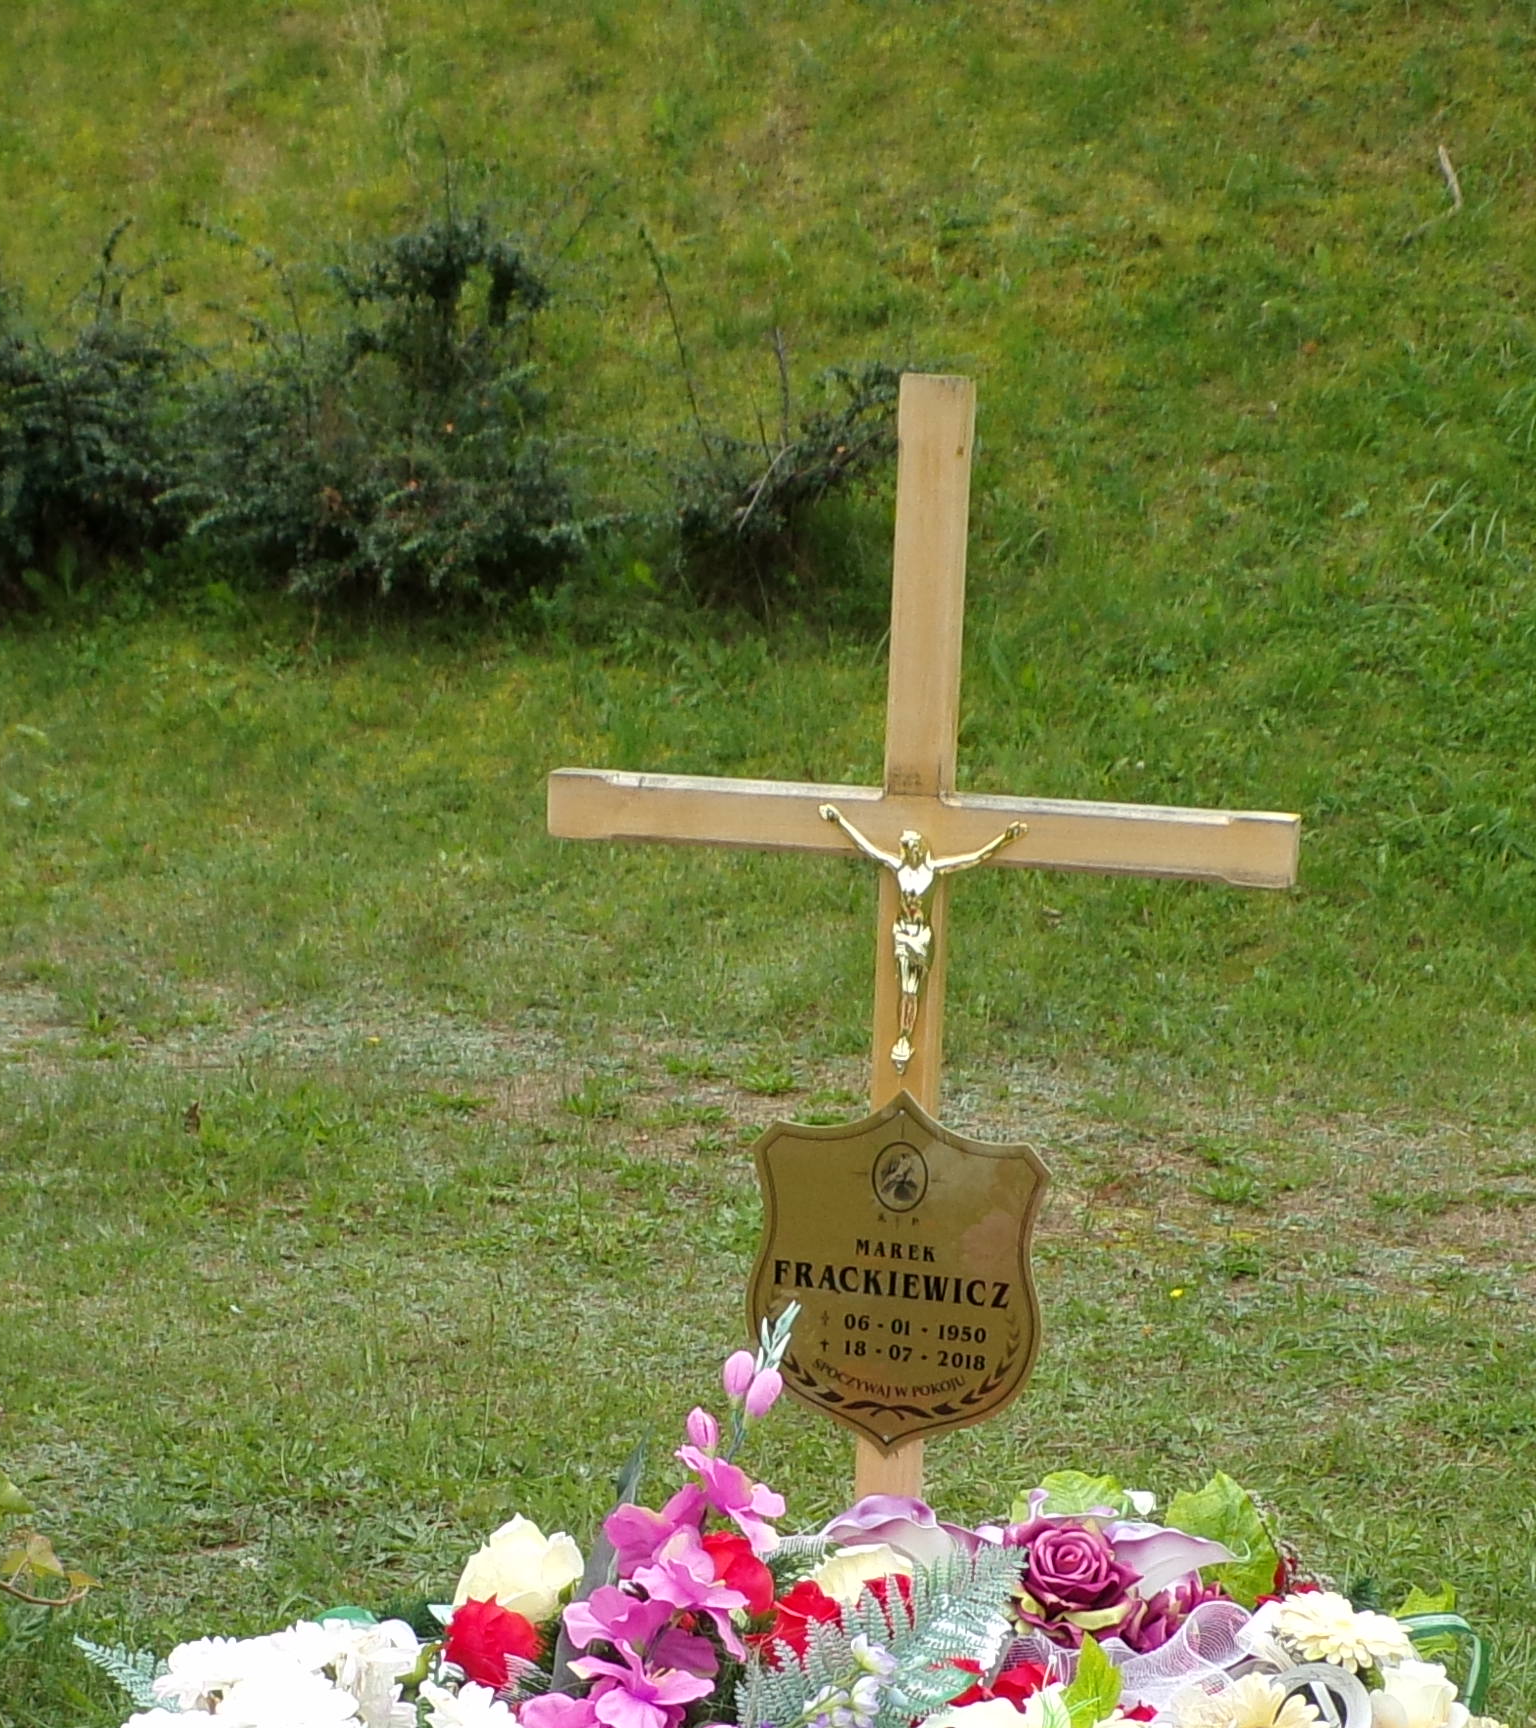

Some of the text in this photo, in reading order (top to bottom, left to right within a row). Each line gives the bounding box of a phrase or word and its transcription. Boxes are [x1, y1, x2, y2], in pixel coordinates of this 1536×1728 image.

[855, 1237, 937, 1263] MAREK
[813, 1357, 967, 1399] SPOCZYWAJ W POKOJU
